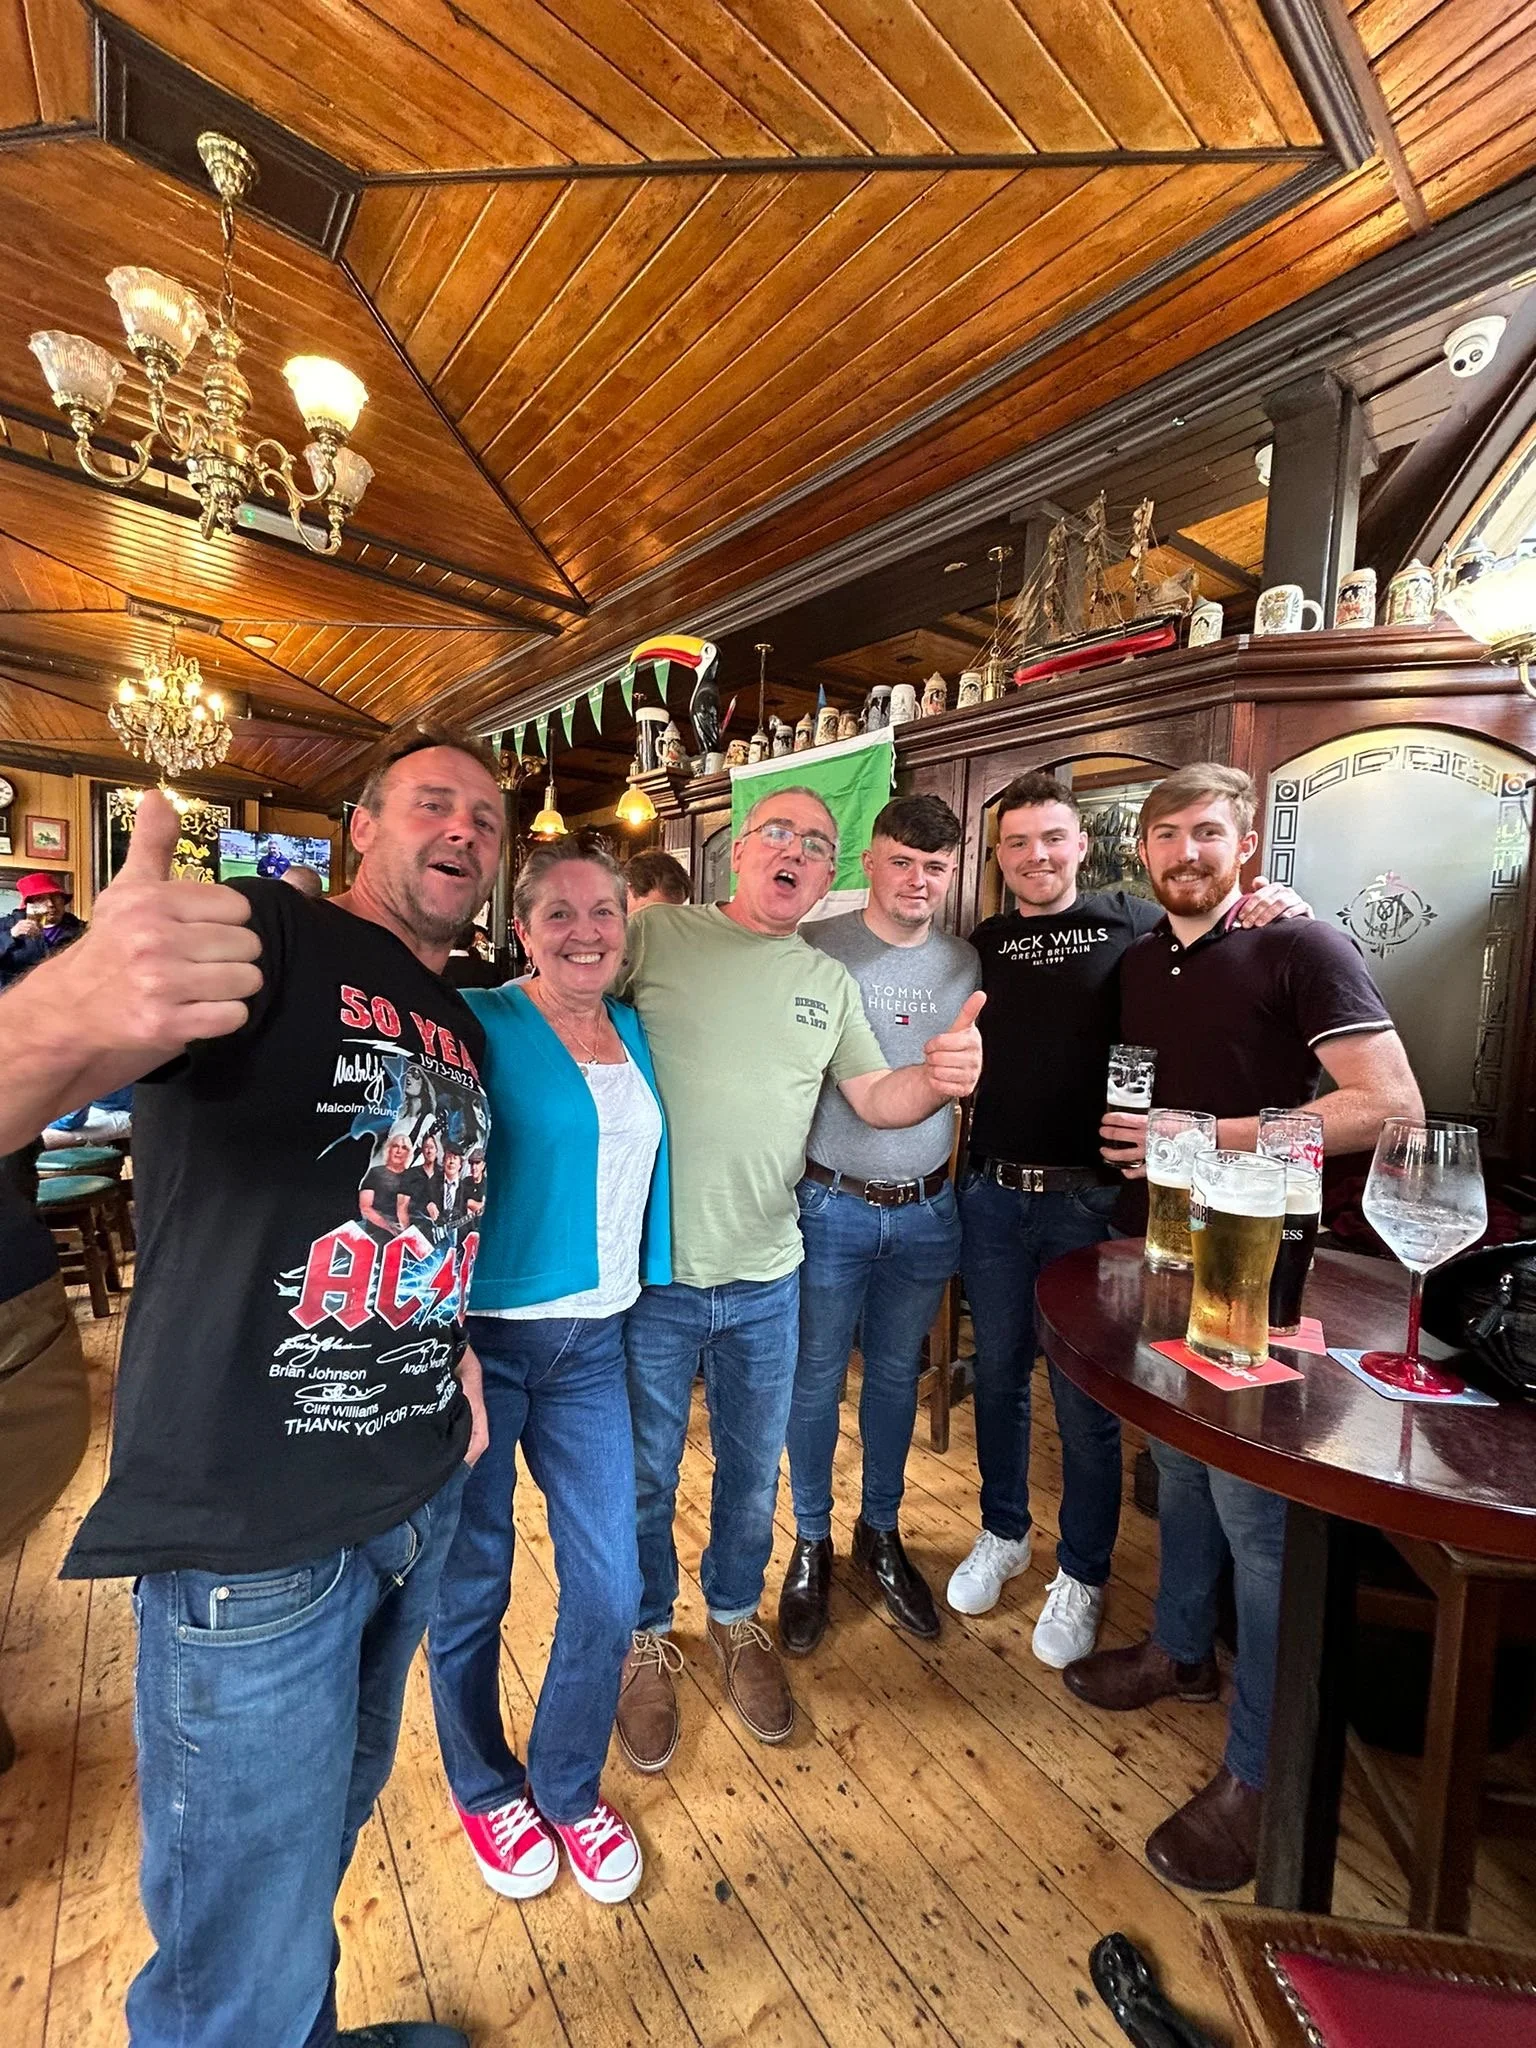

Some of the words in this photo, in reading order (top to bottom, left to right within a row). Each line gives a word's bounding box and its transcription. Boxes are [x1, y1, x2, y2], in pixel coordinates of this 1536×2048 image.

[998, 934, 1044, 954] JACK
[1049, 928, 1109, 946] WILLS
[1011, 950, 1042, 961] GREAT
[1047, 944, 1091, 957] BRITAIN
[1045, 956, 1065, 966] 1999
[871, 983, 933, 1001] TOMMY
[340, 984, 402, 1037] 50
[868, 996, 938, 1014] HILFIGER
[419, 1053, 475, 1090] 1973-2023
[316, 1102, 365, 1114] Malcolm
[367, 1104, 399, 1121] Young
[269, 1364, 306, 1378] Brian
[308, 1367, 367, 1380] Johnson
[284, 1417, 351, 1436] THANK
[354, 1415, 383, 1436] YOU
[384, 1406, 408, 1427] FOR
[409, 1402, 438, 1417] THE
[303, 1403, 330, 1415] Cliff
[332, 1403, 379, 1418] Williams
